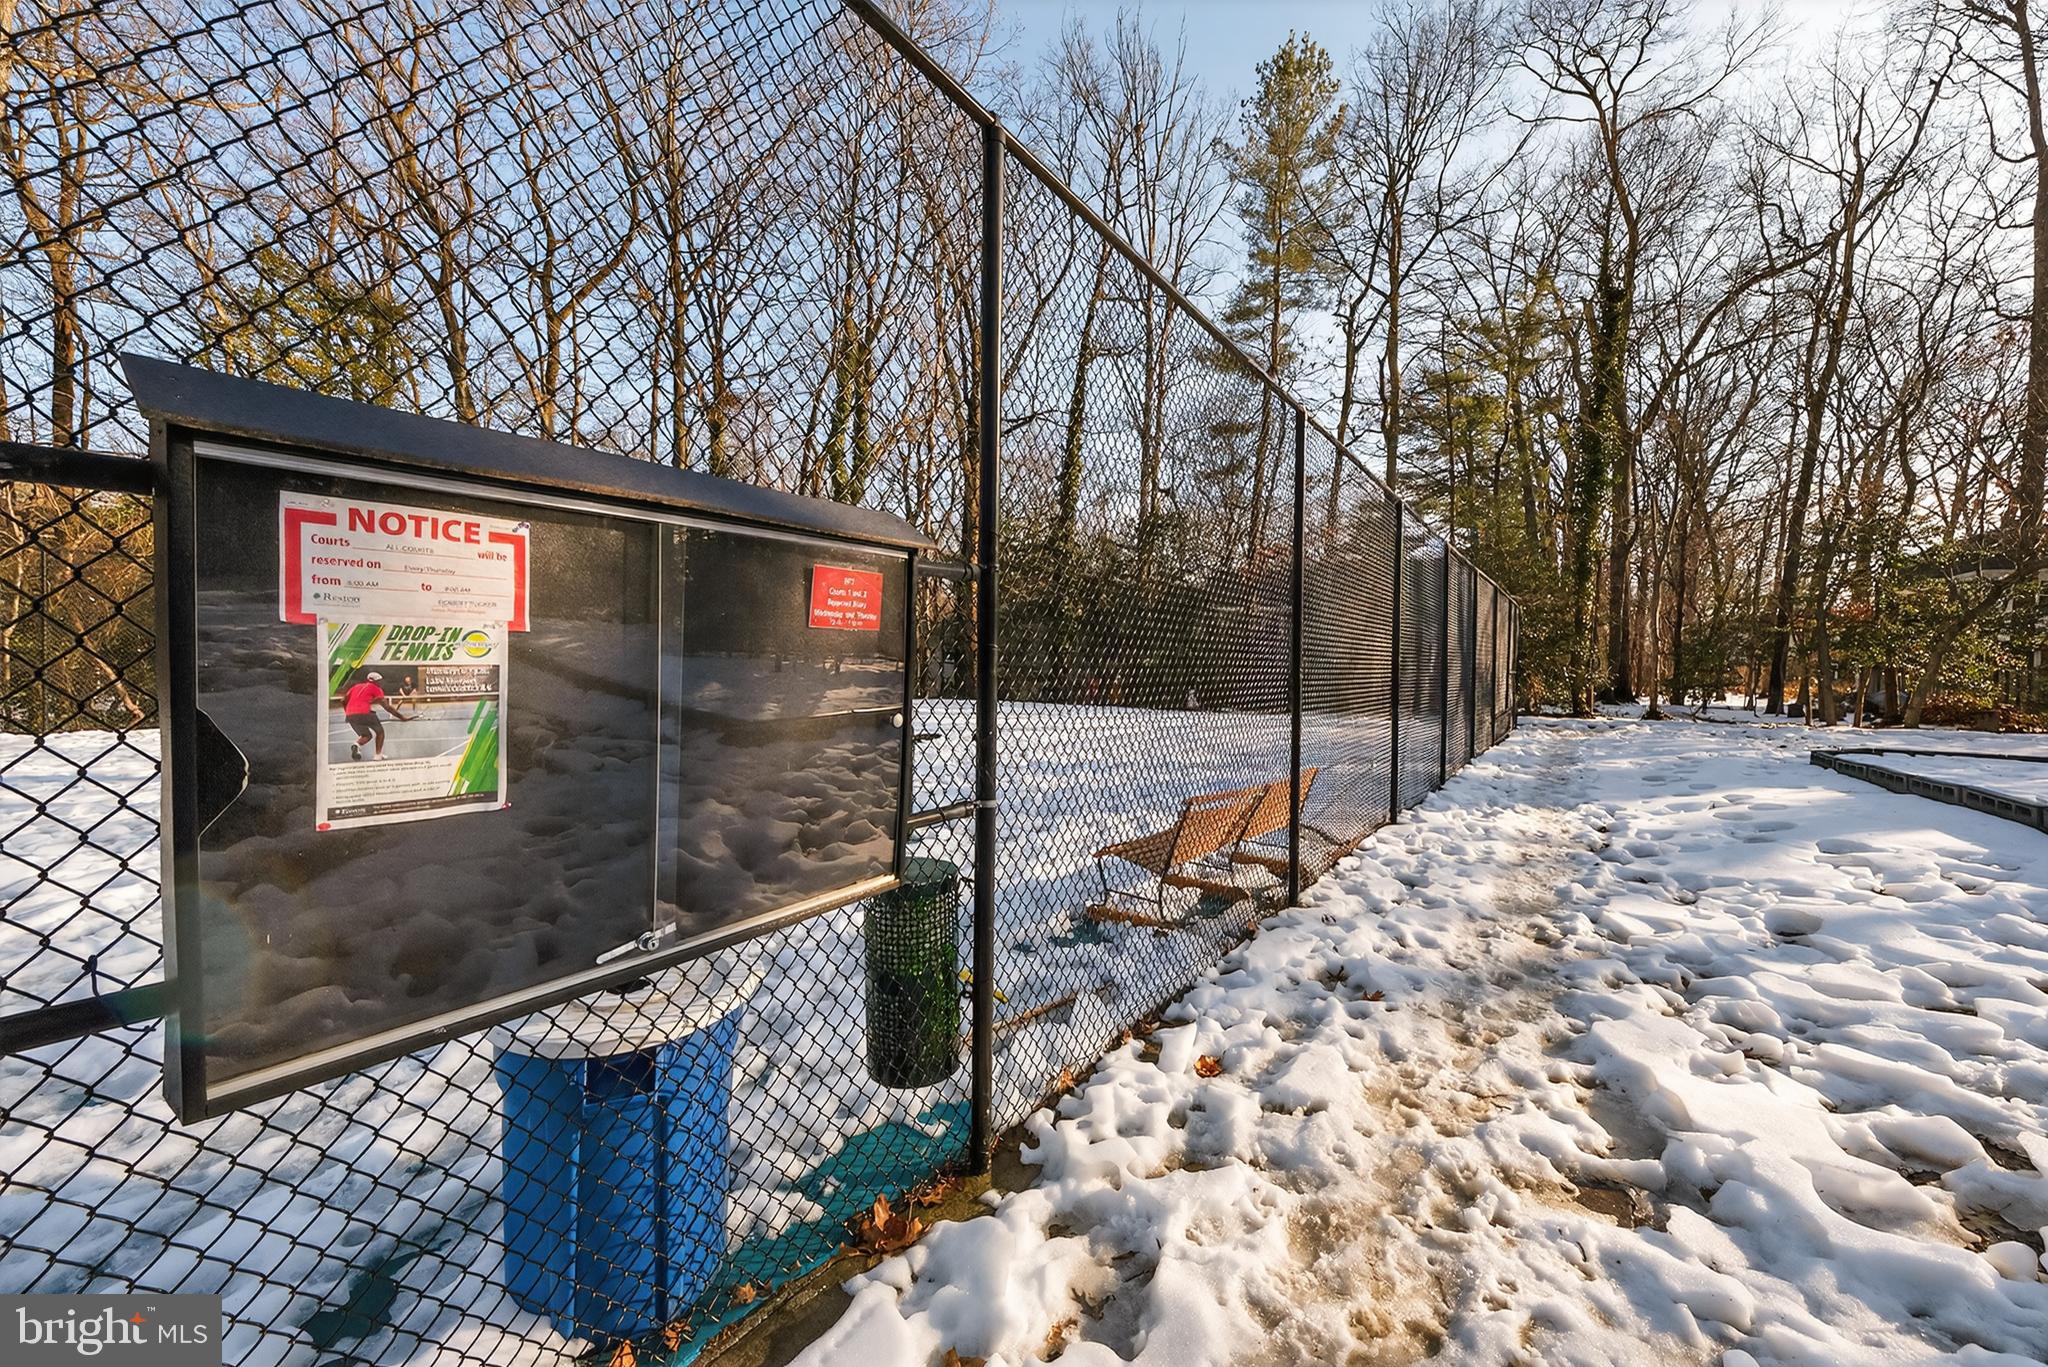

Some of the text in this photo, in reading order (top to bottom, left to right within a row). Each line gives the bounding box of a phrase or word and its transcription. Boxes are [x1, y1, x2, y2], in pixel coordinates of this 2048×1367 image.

[348, 507, 481, 545] NOTICE
[311, 534, 350, 547] Courts
[477, 550, 494, 560] will
[496, 552, 508, 561] be
[311, 556, 382, 569] reserved on
[311, 574, 342, 586] from
[421, 583, 432, 591] to
[386, 625, 463, 643] DROP-IN
[380, 642, 456, 661] TENNIS
